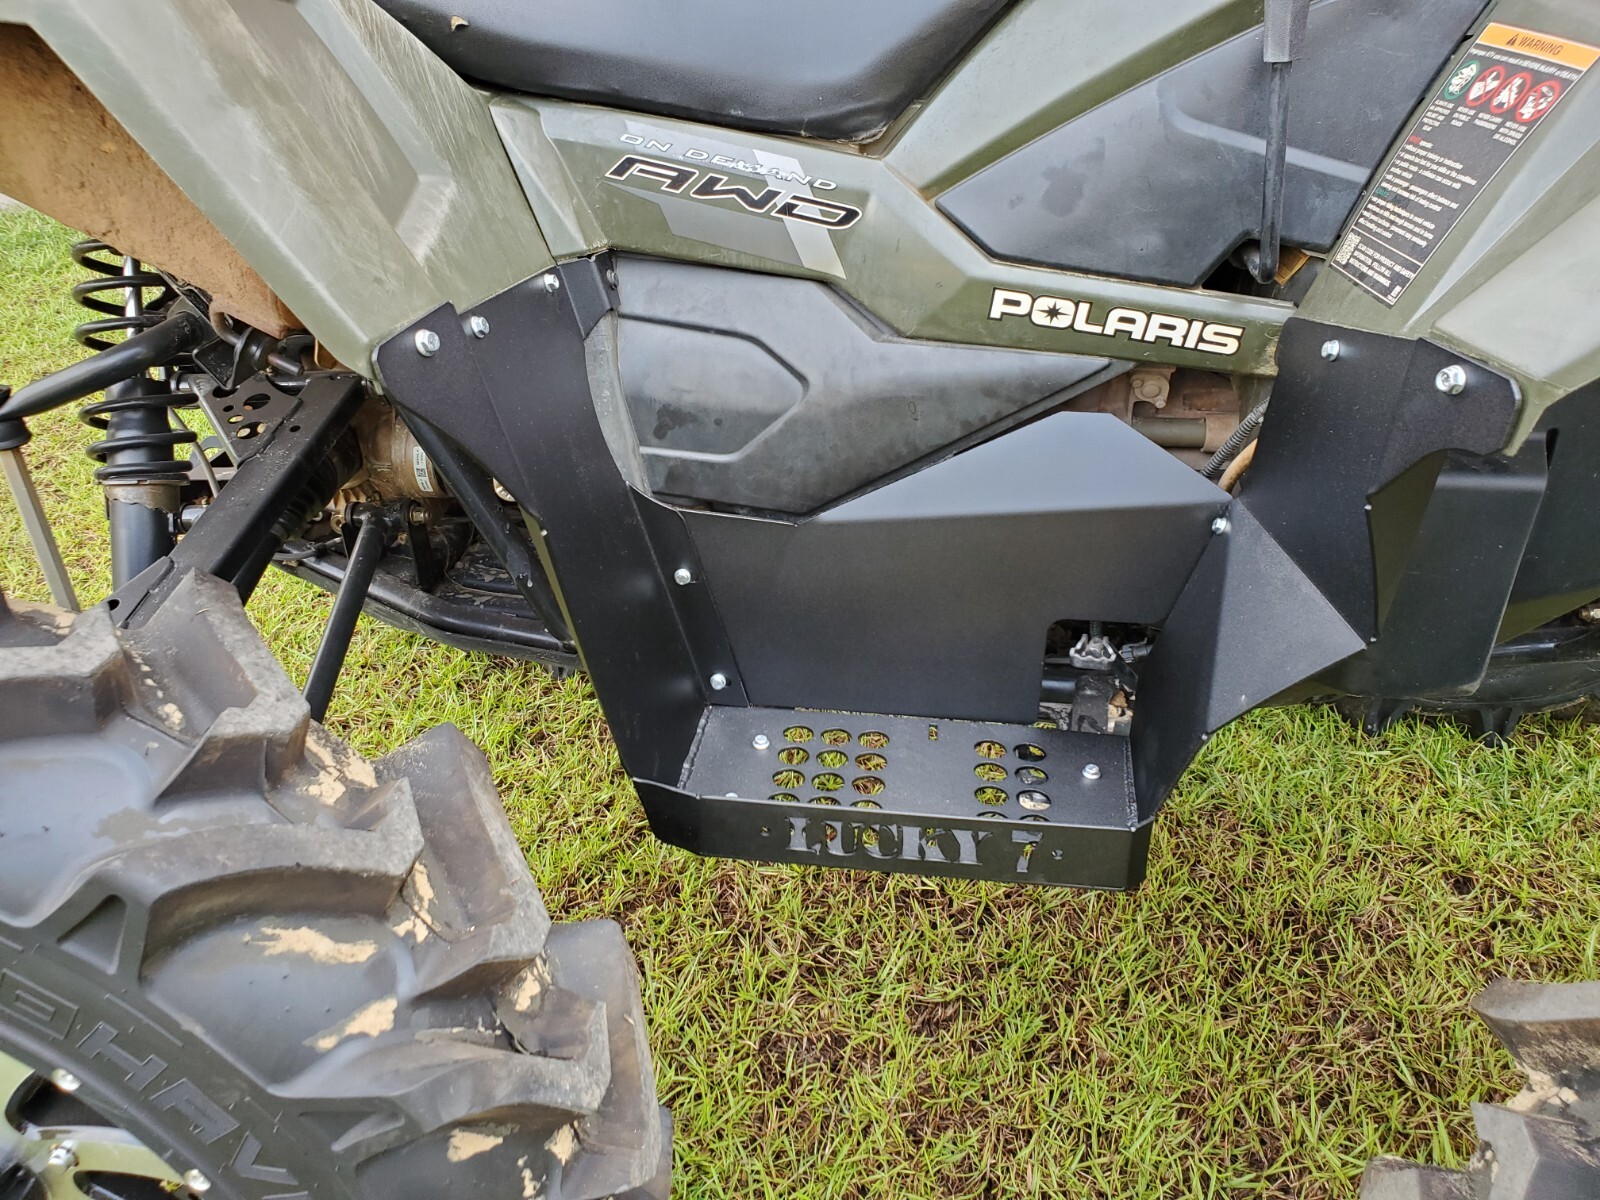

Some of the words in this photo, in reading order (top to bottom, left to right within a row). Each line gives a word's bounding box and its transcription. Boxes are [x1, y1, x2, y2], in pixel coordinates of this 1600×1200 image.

[1518, 36, 1564, 56] WARNING
[619, 131, 673, 152] ON
[685, 148, 837, 190] DEMAND
[604, 154, 863, 230] AWD
[987, 287, 1246, 356] POLARIS
[785, 817, 993, 866] LUCKY
[1011, 830, 1045, 874] 7
